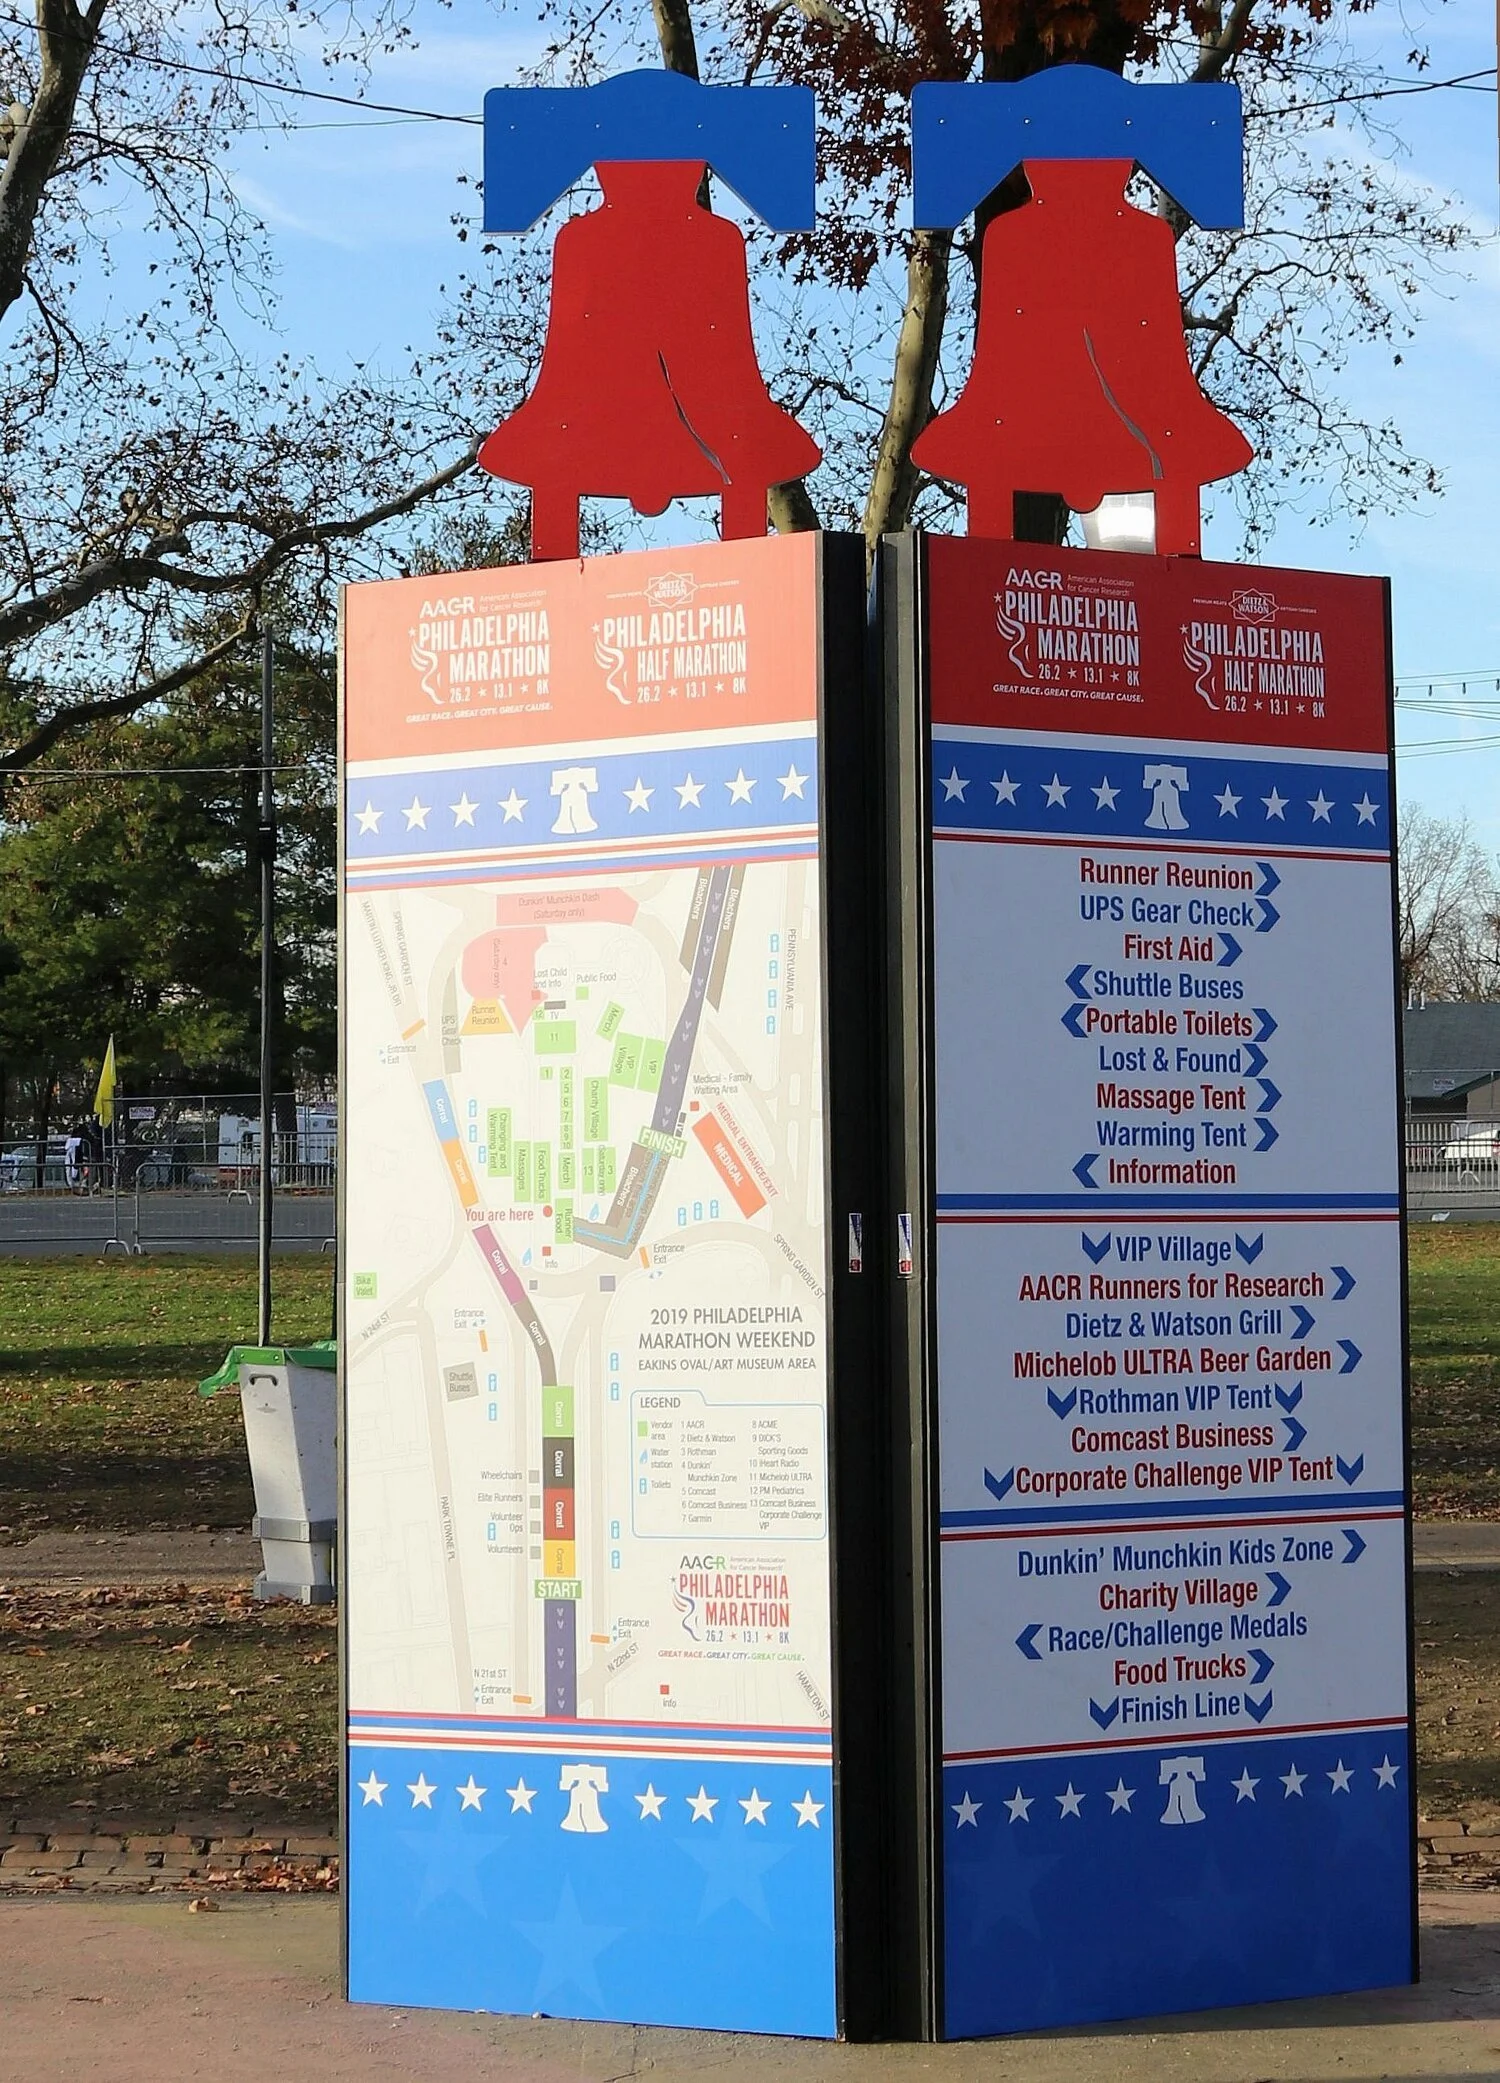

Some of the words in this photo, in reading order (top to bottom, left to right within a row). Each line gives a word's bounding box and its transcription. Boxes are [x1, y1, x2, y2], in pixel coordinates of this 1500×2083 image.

[1005, 568, 1063, 590] AACR
[1067, 575, 1097, 584] American
[1099, 577, 1134, 586] Association
[1078, 585, 1100, 594] Cancer
[420, 597, 475, 618] AACR
[1005, 591, 1138, 632] PHILADELPHIA
[1238, 604, 1269, 614] WATSON
[419, 610, 549, 651] PHILADELPHIA
[603, 604, 746, 648] PHILADELPHIA
[1038, 628, 1139, 666] MARATHON
[1191, 622, 1323, 663] PHILADELPHIA
[450, 644, 550, 683] MARATHON
[638, 648, 669, 682] HALF
[674, 640, 746, 679] MARATHON
[1038, 664, 1060, 680] 26.2
[1084, 668, 1102, 683] 13.1
[1127, 670, 1139, 686] 8K
[1225, 660, 1254, 692] HALF
[1259, 663, 1324, 698] MARATHON
[450, 687, 470, 703] 26.2
[494, 683, 512, 698] 13.1
[537, 679, 549, 695] 8K
[638, 686, 660, 703] 26.2
[686, 681, 705, 698] 13.1
[733, 677, 746, 694] 8K
[993, 684, 1018, 693] GREAT
[1020, 686, 1043, 695] RACE.
[1044, 688, 1069, 697] GREAT
[1070, 690, 1088, 698] CITY.
[1090, 691, 1114, 700] GREAT
[1116, 693, 1144, 702] CAUSE.
[406, 714, 429, 723] GREAT
[431, 712, 453, 721] RACE.
[455, 710, 478, 719] GREAT
[499, 705, 524, 714] GREAT
[526, 702, 552, 711] CAUSE.
[1225, 695, 1246, 712] 26.2
[1270, 699, 1288, 715] 13.1
[1312, 702, 1325, 718] 8K
[1080, 857, 1159, 886] Runner
[1166, 862, 1253, 890] Reunion
[691, 878, 708, 920] Bleachers
[723, 888, 739, 930] Bleachers
[1081, 895, 1124, 921] UPS
[1131, 897, 1181, 923] Gear
[1189, 900, 1254, 926] Check
[786, 928, 796, 992] PENNSYLVANIA
[1124, 934, 1172, 960] First
[1178, 936, 1213, 962] Aid
[577, 973, 597, 982] Public
[600, 972, 616, 981] Food
[1094, 970, 1172, 997] Shuttle
[1179, 974, 1243, 999] Buses
[785, 994, 793, 1010] AVE
[1086, 1008, 1177, 1034] Portable
[1183, 1010, 1252, 1037] Toilets
[1100, 1046, 1146, 1071] Lost
[1152, 1047, 1168, 1072] &
[1177, 1048, 1241, 1073] Found
[590, 1080, 599, 1109] Charity
[1097, 1083, 1194, 1115] Massage
[1200, 1085, 1246, 1110] Tent
[436, 1098, 448, 1123] Corral
[641, 1130, 682, 1157] FINISH
[716, 1102, 740, 1137] MEDICAL
[737, 1135, 779, 1198] ENTRANCE/EXIT
[1097, 1121, 1195, 1152] Warming
[1201, 1122, 1246, 1147] Tent
[455, 1160, 469, 1184] Corral
[714, 1142, 742, 1187] MEDICAL
[1109, 1159, 1236, 1184] Information
[617, 1167, 638, 1206] Bleachers
[465, 1209, 484, 1221] You
[488, 1210, 505, 1221] are
[509, 1208, 533, 1220] here
[492, 1250, 508, 1275] Corral
[1116, 1236, 1152, 1262] VIP
[1158, 1235, 1232, 1267] Village
[774, 1234, 794, 1262] SPRING
[794, 1261, 815, 1288] GARDEN
[814, 1286, 825, 1299] ST
[1019, 1275, 1081, 1301] AACR
[1089, 1275, 1180, 1301] Runners
[1188, 1273, 1218, 1298] for
[1225, 1271, 1324, 1298] Research
[651, 1309, 688, 1325] 2019
[694, 1307, 802, 1324] PHILADELPHIA
[1066, 1313, 1121, 1339] Dietz
[1129, 1312, 1145, 1337] &
[1151, 1311, 1231, 1337] Watson
[1239, 1309, 1282, 1336] Grill
[529, 1321, 545, 1346] Corral
[639, 1333, 730, 1349] MARATHON
[736, 1331, 815, 1348] WEEKEND
[638, 1359, 677, 1371] EAKINS
[680, 1359, 733, 1370] OVAL/ART
[737, 1358, 784, 1369] MUSEUM
[788, 1358, 816, 1369] AREA
[1014, 1352, 1116, 1378] Michelob
[1124, 1349, 1193, 1375] ULTRA
[1201, 1348, 1249, 1373] Beer
[1256, 1345, 1331, 1372] Garden
[450, 1372, 472, 1381] Shuttle
[450, 1383, 470, 1392] Buses
[640, 1397, 680, 1408] LEGEND
[1080, 1388, 1179, 1414] Rothman
[1185, 1386, 1220, 1411] VIP
[1226, 1385, 1272, 1409] Tent
[556, 1401, 564, 1427] Corral
[1072, 1426, 1169, 1453] Comcast
[1176, 1422, 1273, 1450] Business
[481, 1471, 522, 1479] Wheelchairs
[1016, 1465, 1127, 1497] Corporate
[1134, 1461, 1242, 1490] Challenge
[1248, 1458, 1283, 1483] VIP
[1289, 1456, 1333, 1481] Tent
[556, 1501, 564, 1528] Corral
[556, 1548, 564, 1573] Corral
[680, 1555, 726, 1569] AACR
[1018, 1548, 1104, 1577] Dunkin'
[1113, 1542, 1222, 1572] Munchkin
[1229, 1539, 1275, 1565] Kids
[1283, 1537, 1334, 1562] Zone
[538, 1583, 578, 1597] START
[680, 1573, 789, 1599] PHILADELPHIA
[1100, 1582, 1178, 1612] Charity
[1184, 1579, 1258, 1608] Village
[706, 1602, 790, 1627] MARATHON
[706, 1630, 723, 1642] 26.2
[743, 1631, 758, 1643] 13.1
[779, 1632, 789, 1643] 8K
[1049, 1619, 1223, 1652] Race/Challenge
[1230, 1612, 1307, 1641] Medals
[707, 1651, 730, 1659] GREAT
[1114, 1658, 1167, 1686] Food
[1173, 1654, 1246, 1680] Trucks
[1122, 1694, 1188, 1723] Finish
[1195, 1692, 1240, 1718] Line
